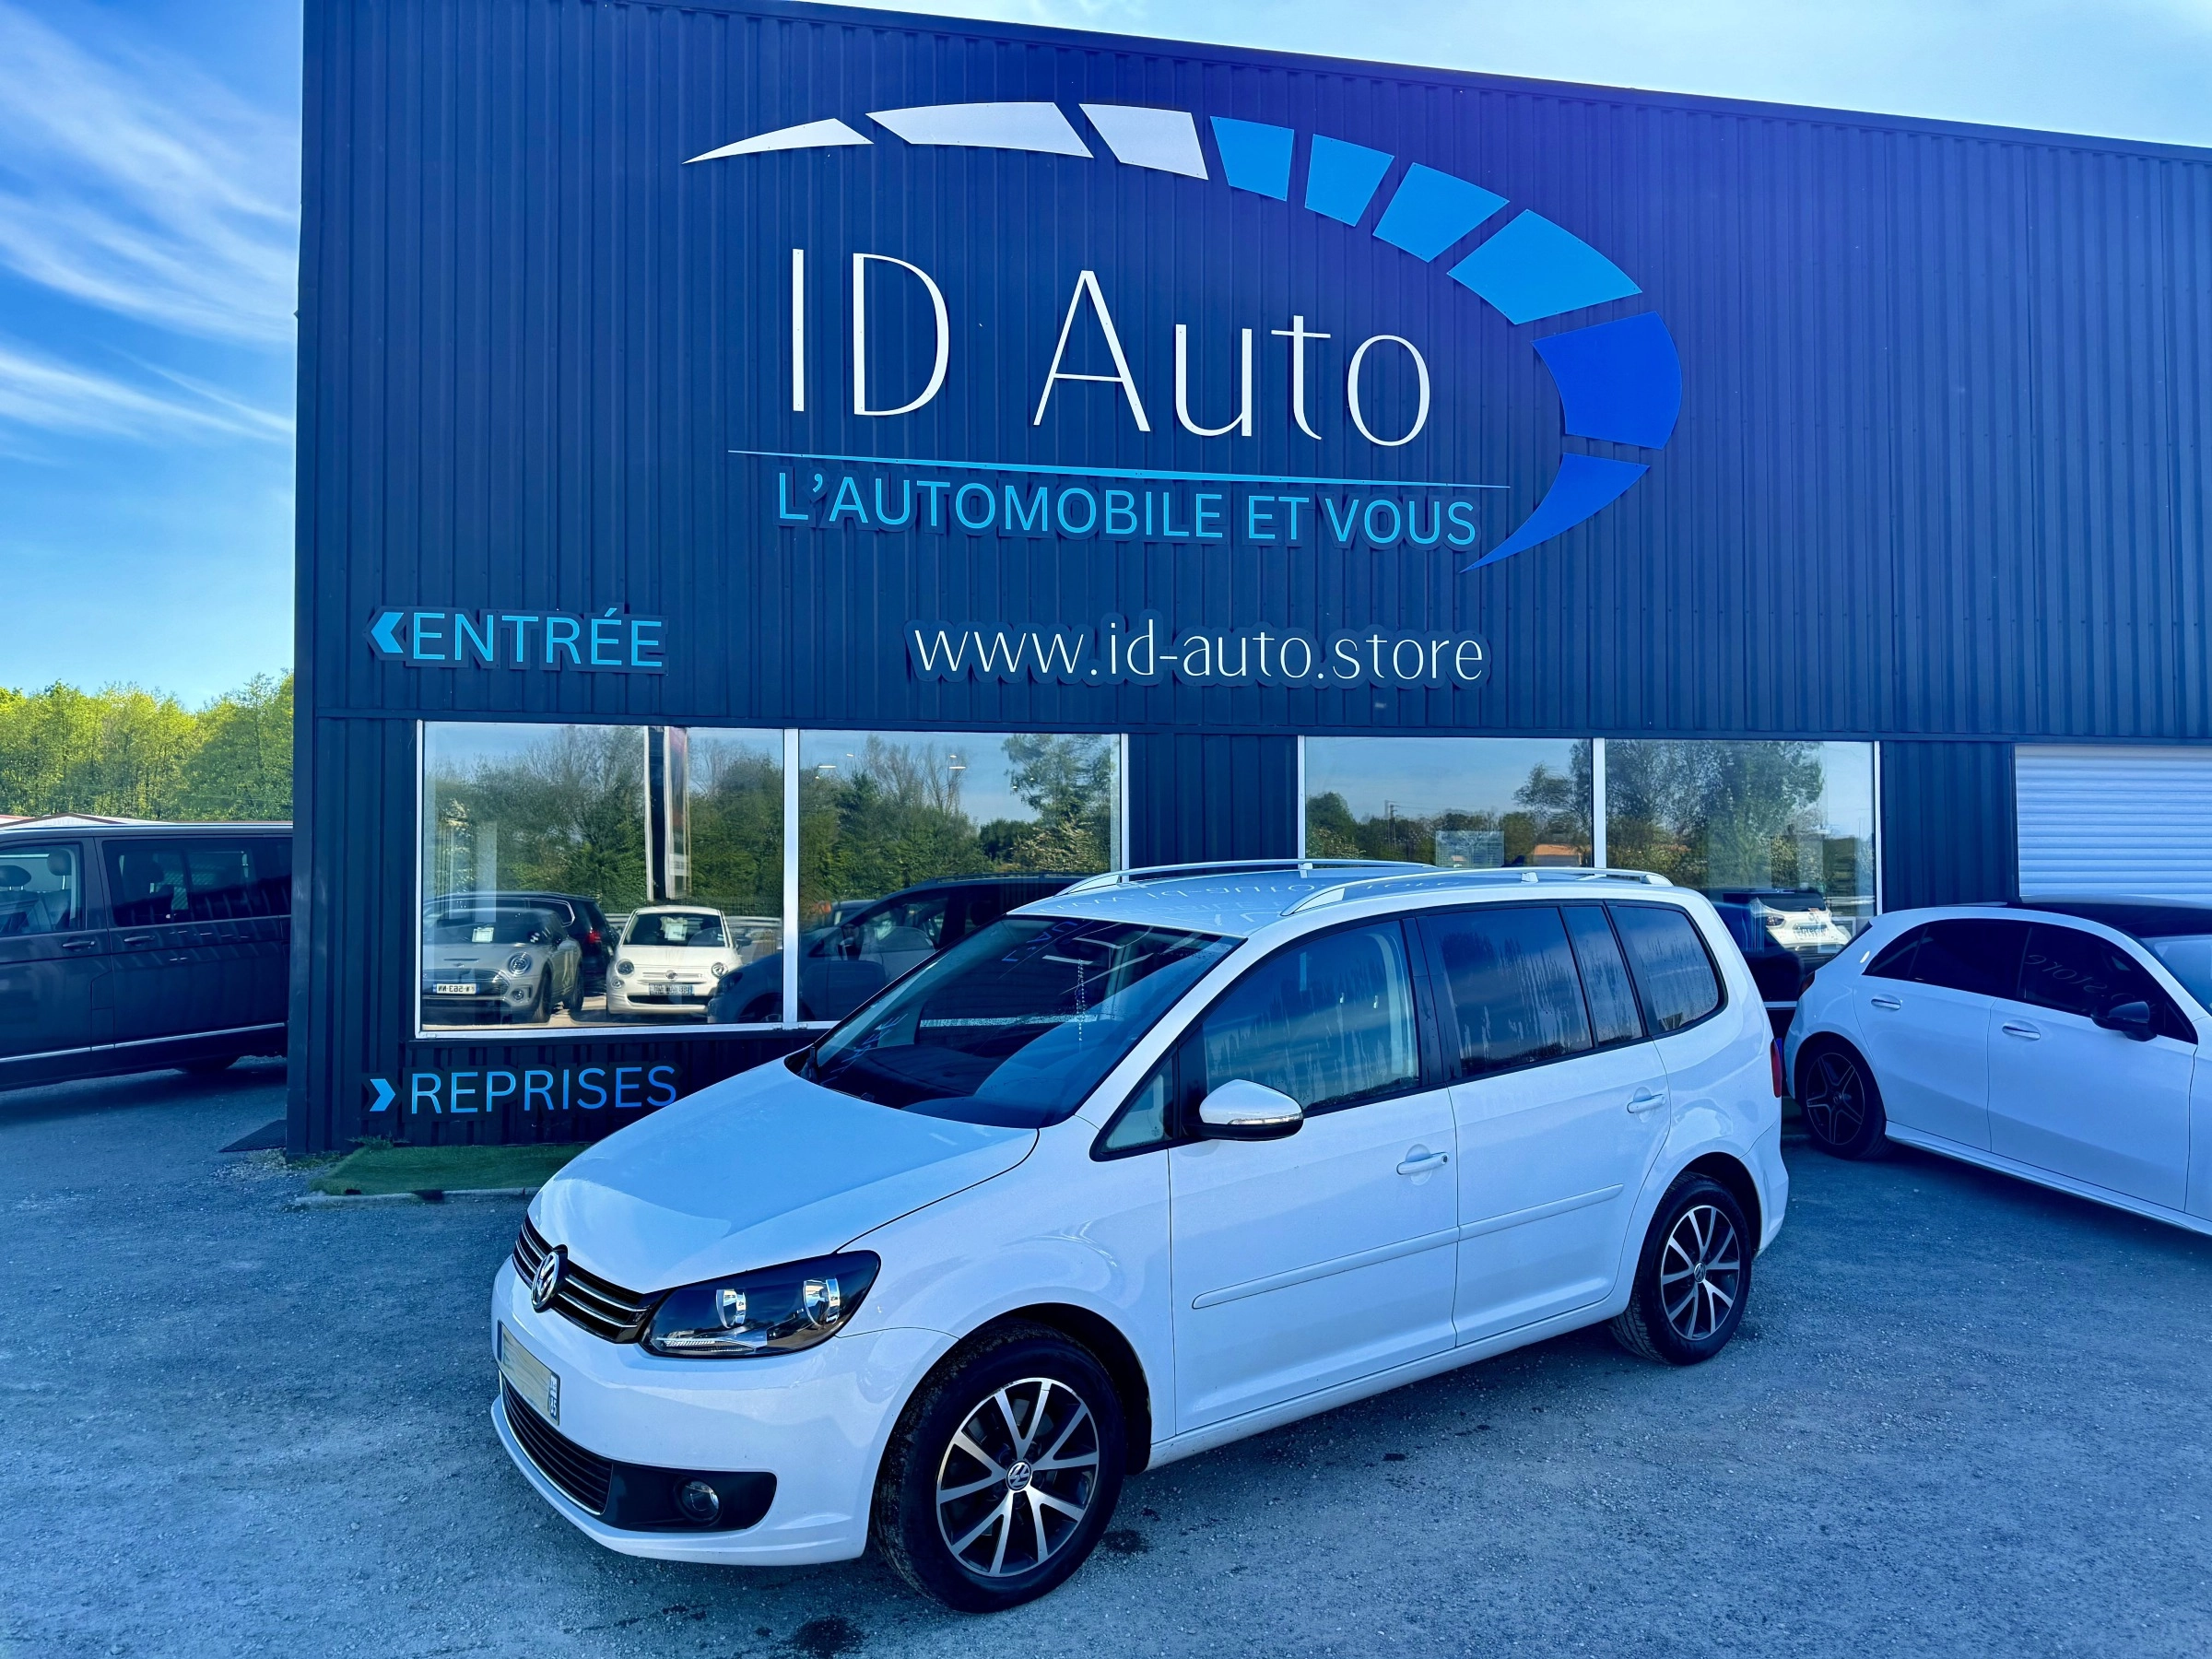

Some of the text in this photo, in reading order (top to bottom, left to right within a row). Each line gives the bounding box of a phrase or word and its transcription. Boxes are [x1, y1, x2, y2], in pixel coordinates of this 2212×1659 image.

[791, 248, 1431, 448] ID Auto
[1247, 494, 1311, 541] ET
[1324, 497, 1477, 547] VOUS
[412, 606, 664, 668] ENTRÉE
[913, 618, 1484, 681] www.id-auto.store
[411, 1065, 677, 1114] REPRISES
